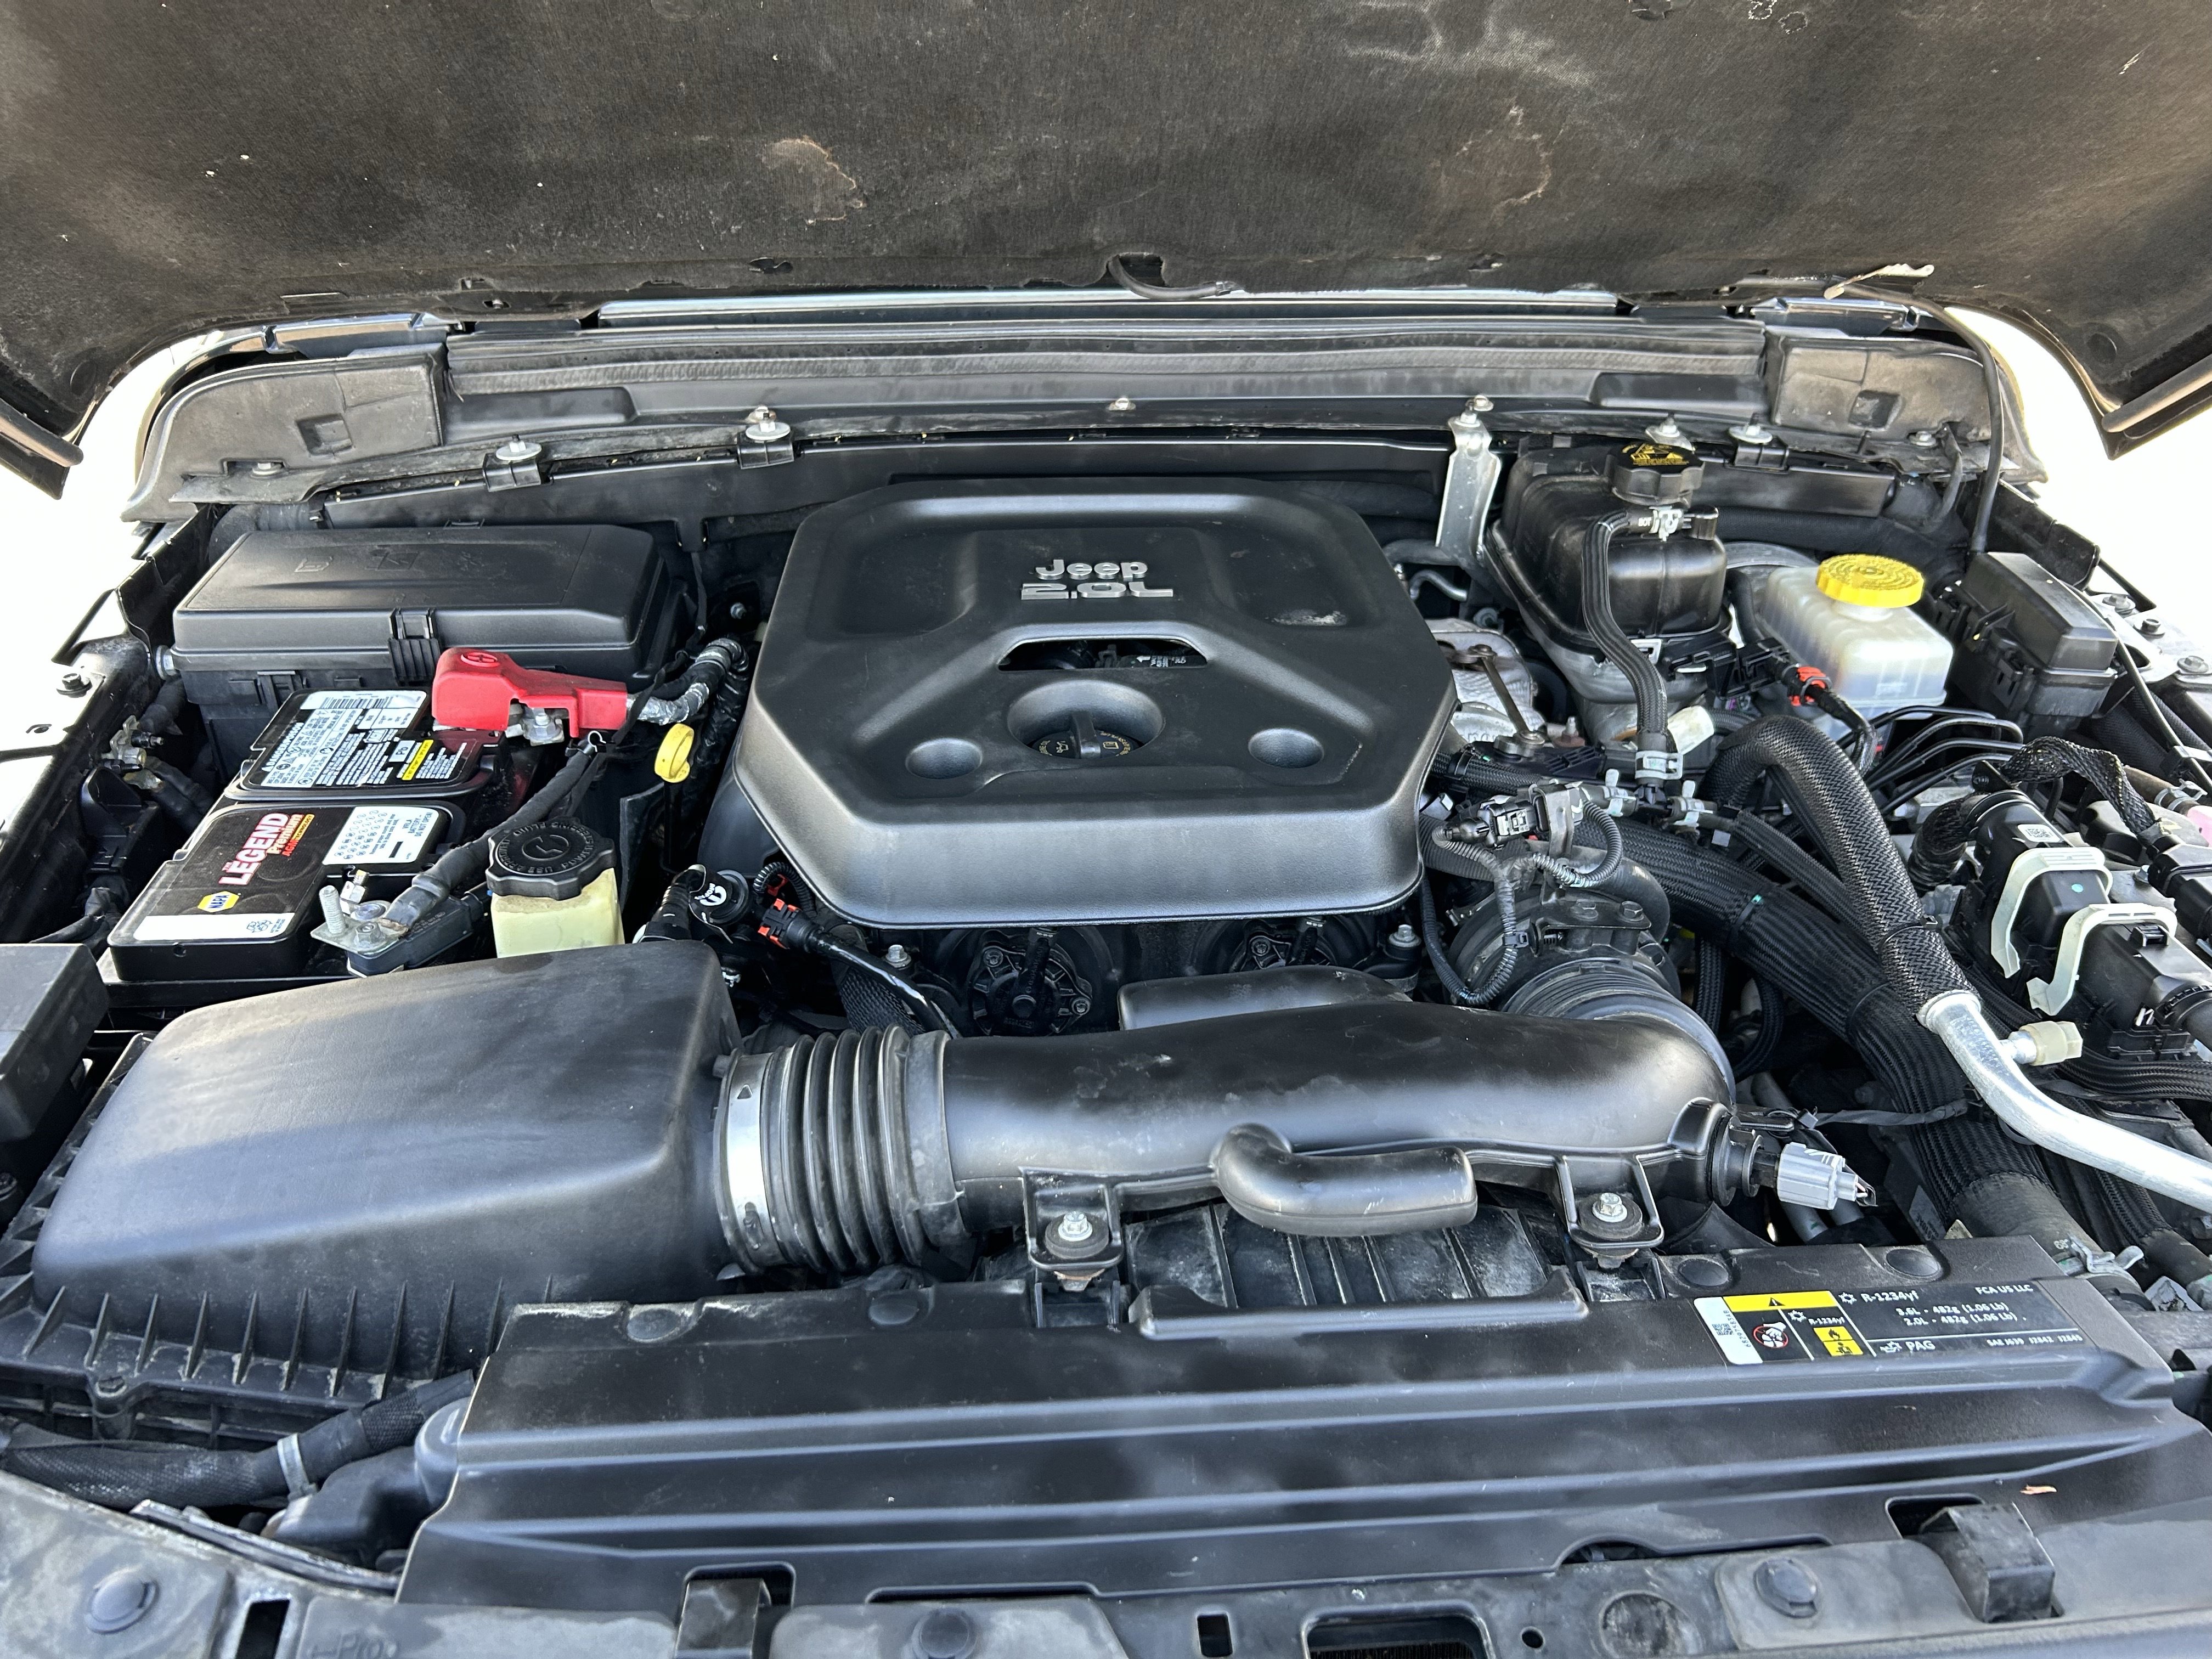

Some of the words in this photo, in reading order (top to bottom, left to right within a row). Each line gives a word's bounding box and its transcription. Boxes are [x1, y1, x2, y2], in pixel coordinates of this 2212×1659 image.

[1035, 558, 1148, 582] Jeep
[1021, 581, 1173, 600] 2.0L
[395, 746, 410, 757] Pb
[267, 814, 304, 855] Premium
[513, 822, 546, 837] FLUID
[218, 812, 291, 885] LEGEND
[281, 838, 300, 857] AGM
[528, 866, 553, 874] USE
[208, 894, 229, 909] NAPA
[1860, 1290, 1920, 1303] R-1234yf
[1975, 1285, 1999, 1295] FCA
[1999, 1284, 2014, 1294] US
[2015, 1284, 2034, 1293] LLC
[1895, 1307, 1921, 1317] 3.6L
[1962, 1302, 1991, 1313] (1.06
[1990, 1301, 2010, 1312] Lb)
[1808, 1316, 1846, 1325] R-1234yf
[1903, 1317, 1929, 1327] 2.0L
[1970, 1312, 1999, 1323] (1.06
[2000, 1311, 2019, 1322] Lb)
[1905, 1340, 1936, 1351] PAG
